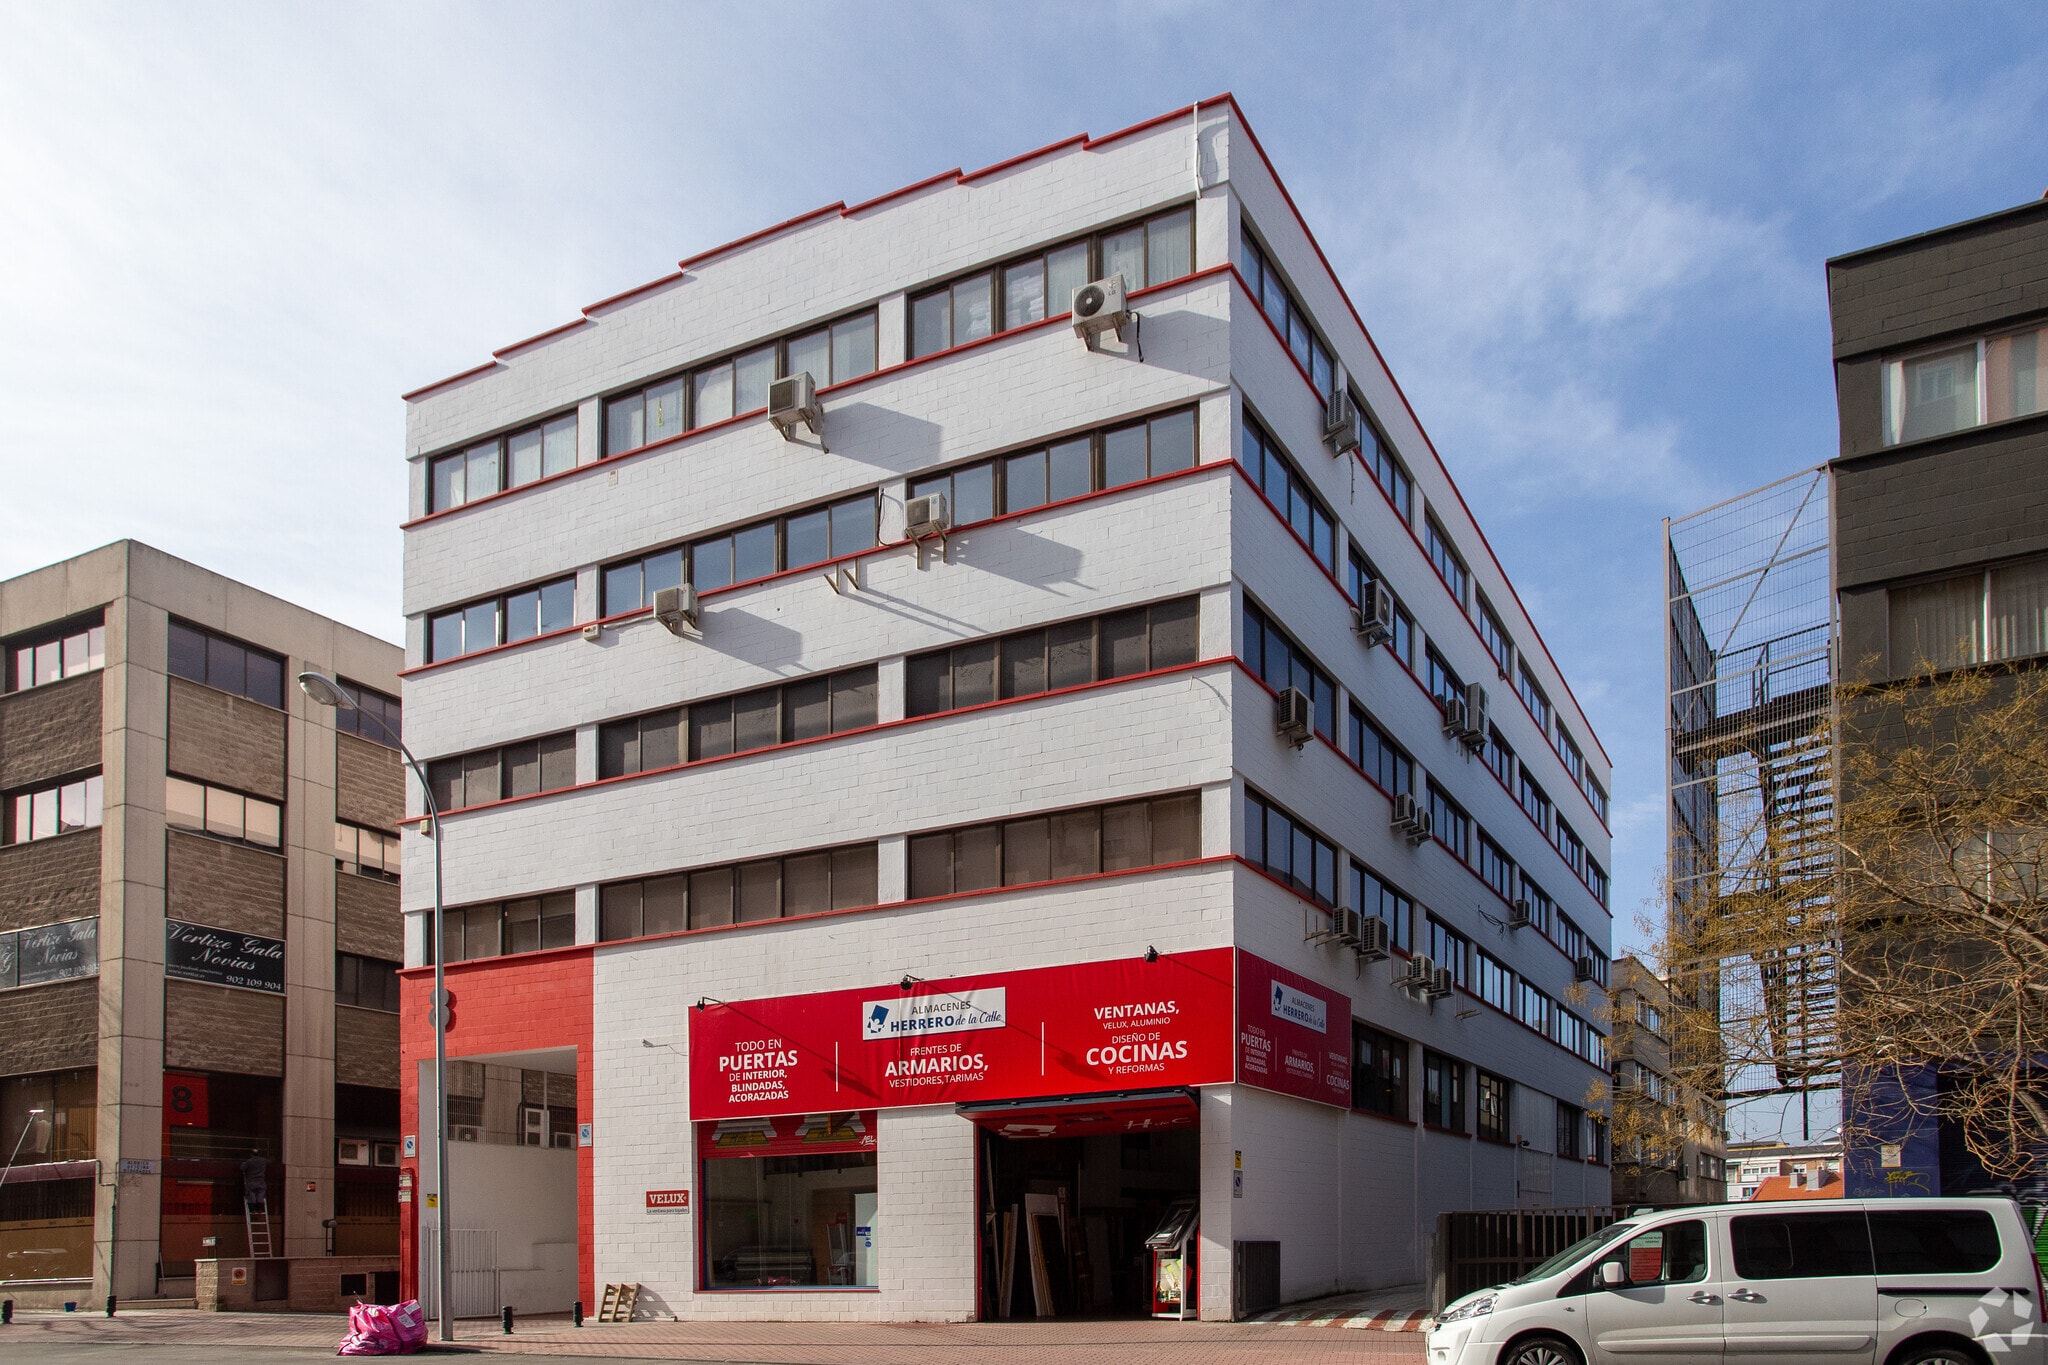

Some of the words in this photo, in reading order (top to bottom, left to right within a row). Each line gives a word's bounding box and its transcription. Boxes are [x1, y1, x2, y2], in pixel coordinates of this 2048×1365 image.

[67, 922, 97, 942] Gala
[167, 923, 232, 950] Vertize
[240, 936, 283, 959] Gala
[191, 947, 256, 971] Novias
[226, 974, 244, 985] 902
[246, 978, 263, 988] 109
[264, 981, 282, 991] 904
[911, 1000, 972, 1016] ALMACENES
[1093, 1000, 1180, 1020] VENTANAS,
[1291, 996, 1315, 1012] ALMACENES
[890, 1015, 954, 1033] HERRERO
[954, 1014, 966, 1026] de
[968, 1013, 978, 1025] la
[979, 1010, 1002, 1024] Calle
[1283, 1004, 1309, 1023] HERRERO
[1103, 1021, 1129, 1030] VELUX,
[1130, 1016, 1171, 1028] ALUMINIO
[735, 1039, 766, 1052] TODO
[768, 1038, 782, 1050] EN
[1111, 1032, 1146, 1044] DISEÑO
[1148, 1031, 1161, 1041] DE
[1240, 1032, 1272, 1052] PUERTAS
[910, 1044, 948, 1057] FRENTES
[950, 1043, 962, 1053] DE
[1086, 1040, 1188, 1066] COCINAS
[719, 1049, 798, 1072] PUERTAS
[884, 1053, 989, 1077] ARMARIOS,
[1108, 1066, 1114, 1075] Y
[1116, 1062, 1165, 1075] REFORMAS
[1284, 1055, 1315, 1075] ARMARIOS,
[729, 1072, 741, 1082] DE
[742, 1069, 788, 1081] INTERIOR,
[889, 1075, 944, 1088] VESTIDORES,
[944, 1072, 984, 1084] TARIMAS
[1326, 1074, 1350, 1090] COCINAS
[731, 1080, 785, 1093] BLINDADAS,
[171, 1085, 193, 1112] 8
[728, 1090, 789, 1103] ACORAZADAS
[649, 1193, 685, 1204] VELUX
